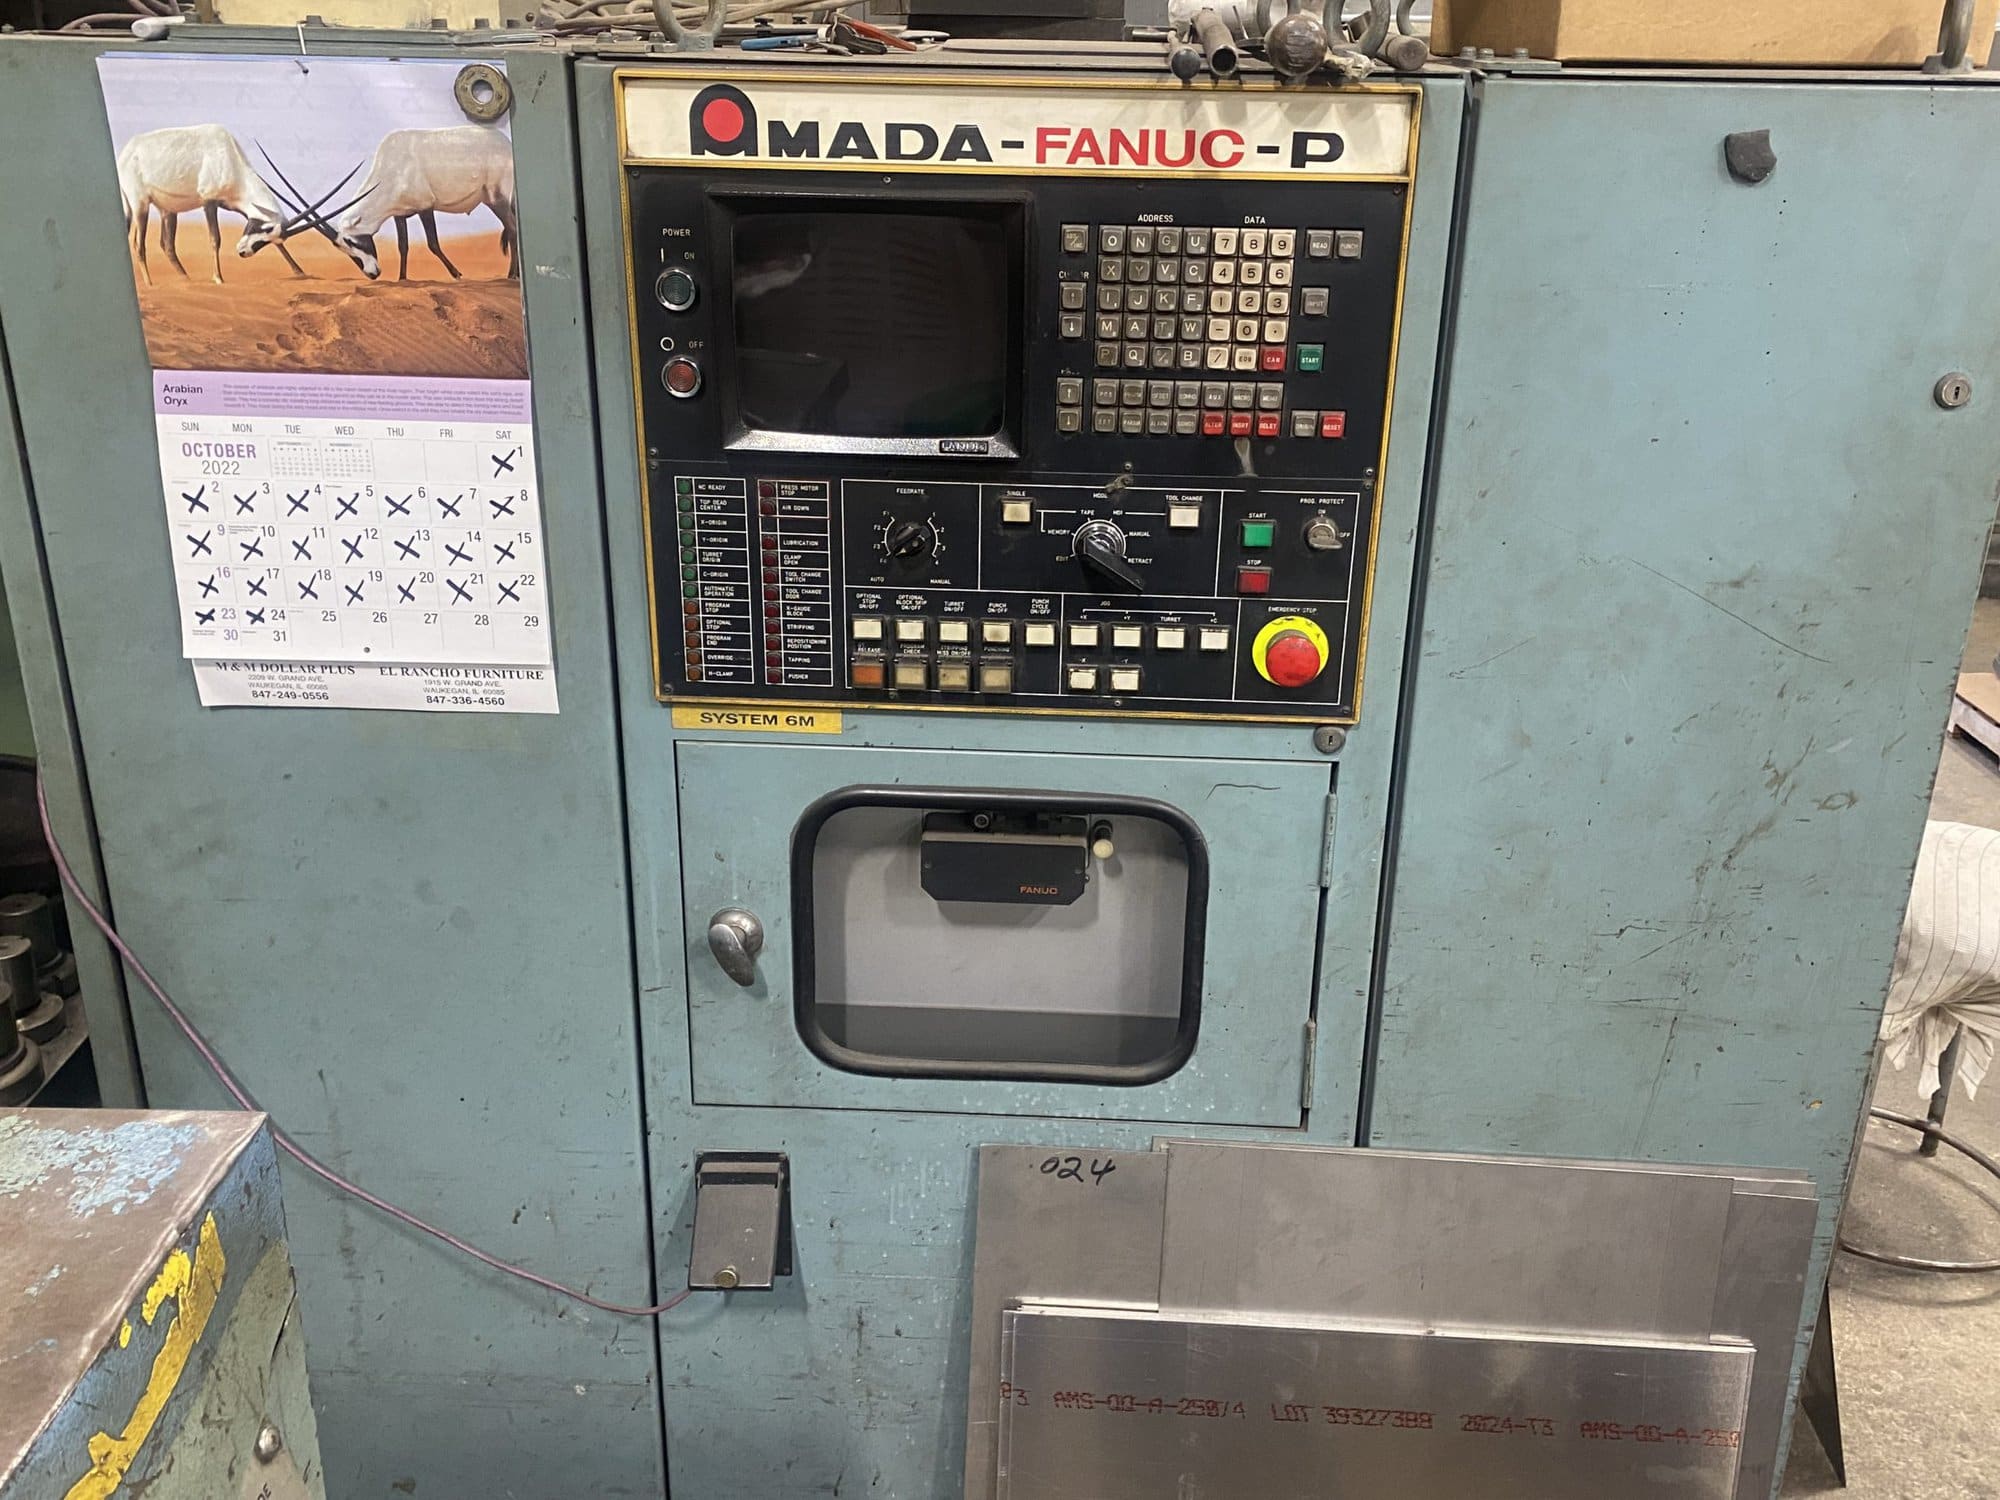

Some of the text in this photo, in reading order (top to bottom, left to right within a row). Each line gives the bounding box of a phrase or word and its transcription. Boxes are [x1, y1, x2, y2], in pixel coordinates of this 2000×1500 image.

[1137, 214, 1174, 223] ADDRESS
[1244, 216, 1266, 224] DATA
[662, 229, 691, 237] POWER
[1136, 237, 1145, 248] N
[1162, 235, 1171, 246] G
[1190, 236, 1201, 247] U
[1221, 238, 1287, 250] 7 8 9
[684, 252, 695, 260] ON
[1106, 264, 1199, 276] X Y V C
[1219, 268, 1284, 279] 4 5 6
[1133, 293, 1196, 305] J K F
[1245, 297, 1282, 308] 2 3
[1101, 321, 1196, 332] M A T W
[688, 341, 704, 349] OFF
[1129, 350, 1193, 360] Q B
[163, 384, 203, 394] Arabian
[164, 396, 188, 407] Oryx
[182, 422, 512, 440] SUN MON TUE WED THU FRI SAT
[182, 443, 257, 458] OCTOBER
[517, 446, 523, 457] 1
[202, 460, 241, 475] 2022
[211, 481, 528, 501] 2 3 4 5 6 7 8
[217, 524, 225, 535] 9
[261, 526, 276, 537] 10
[312, 527, 325, 538] 11
[364, 528, 379, 540] 12
[416, 530, 430, 541] 13
[467, 531, 481, 542] 14
[518, 533, 532, 544] 15
[217, 567, 535, 586] 16 17 18 19 20 21 22
[221, 608, 539, 627] 23 24 25 26 27 28 29
[223, 629, 239, 641] 30
[273, 630, 287, 642] 31
[216, 662, 355, 675] M & M DOLLAR PLUS
[379, 666, 544, 680] EL RANCHO FURNITURE
[252, 690, 329, 700] 847-249-0556
[426, 695, 505, 705] 847-336-4560
[700, 712, 815, 727] SYSTEM 6M
[1020, 886, 1057, 895] FANUC
[1271, 1403, 1313, 1422] LOT
[1459, 1414, 1558, 1436] 2024-T3
